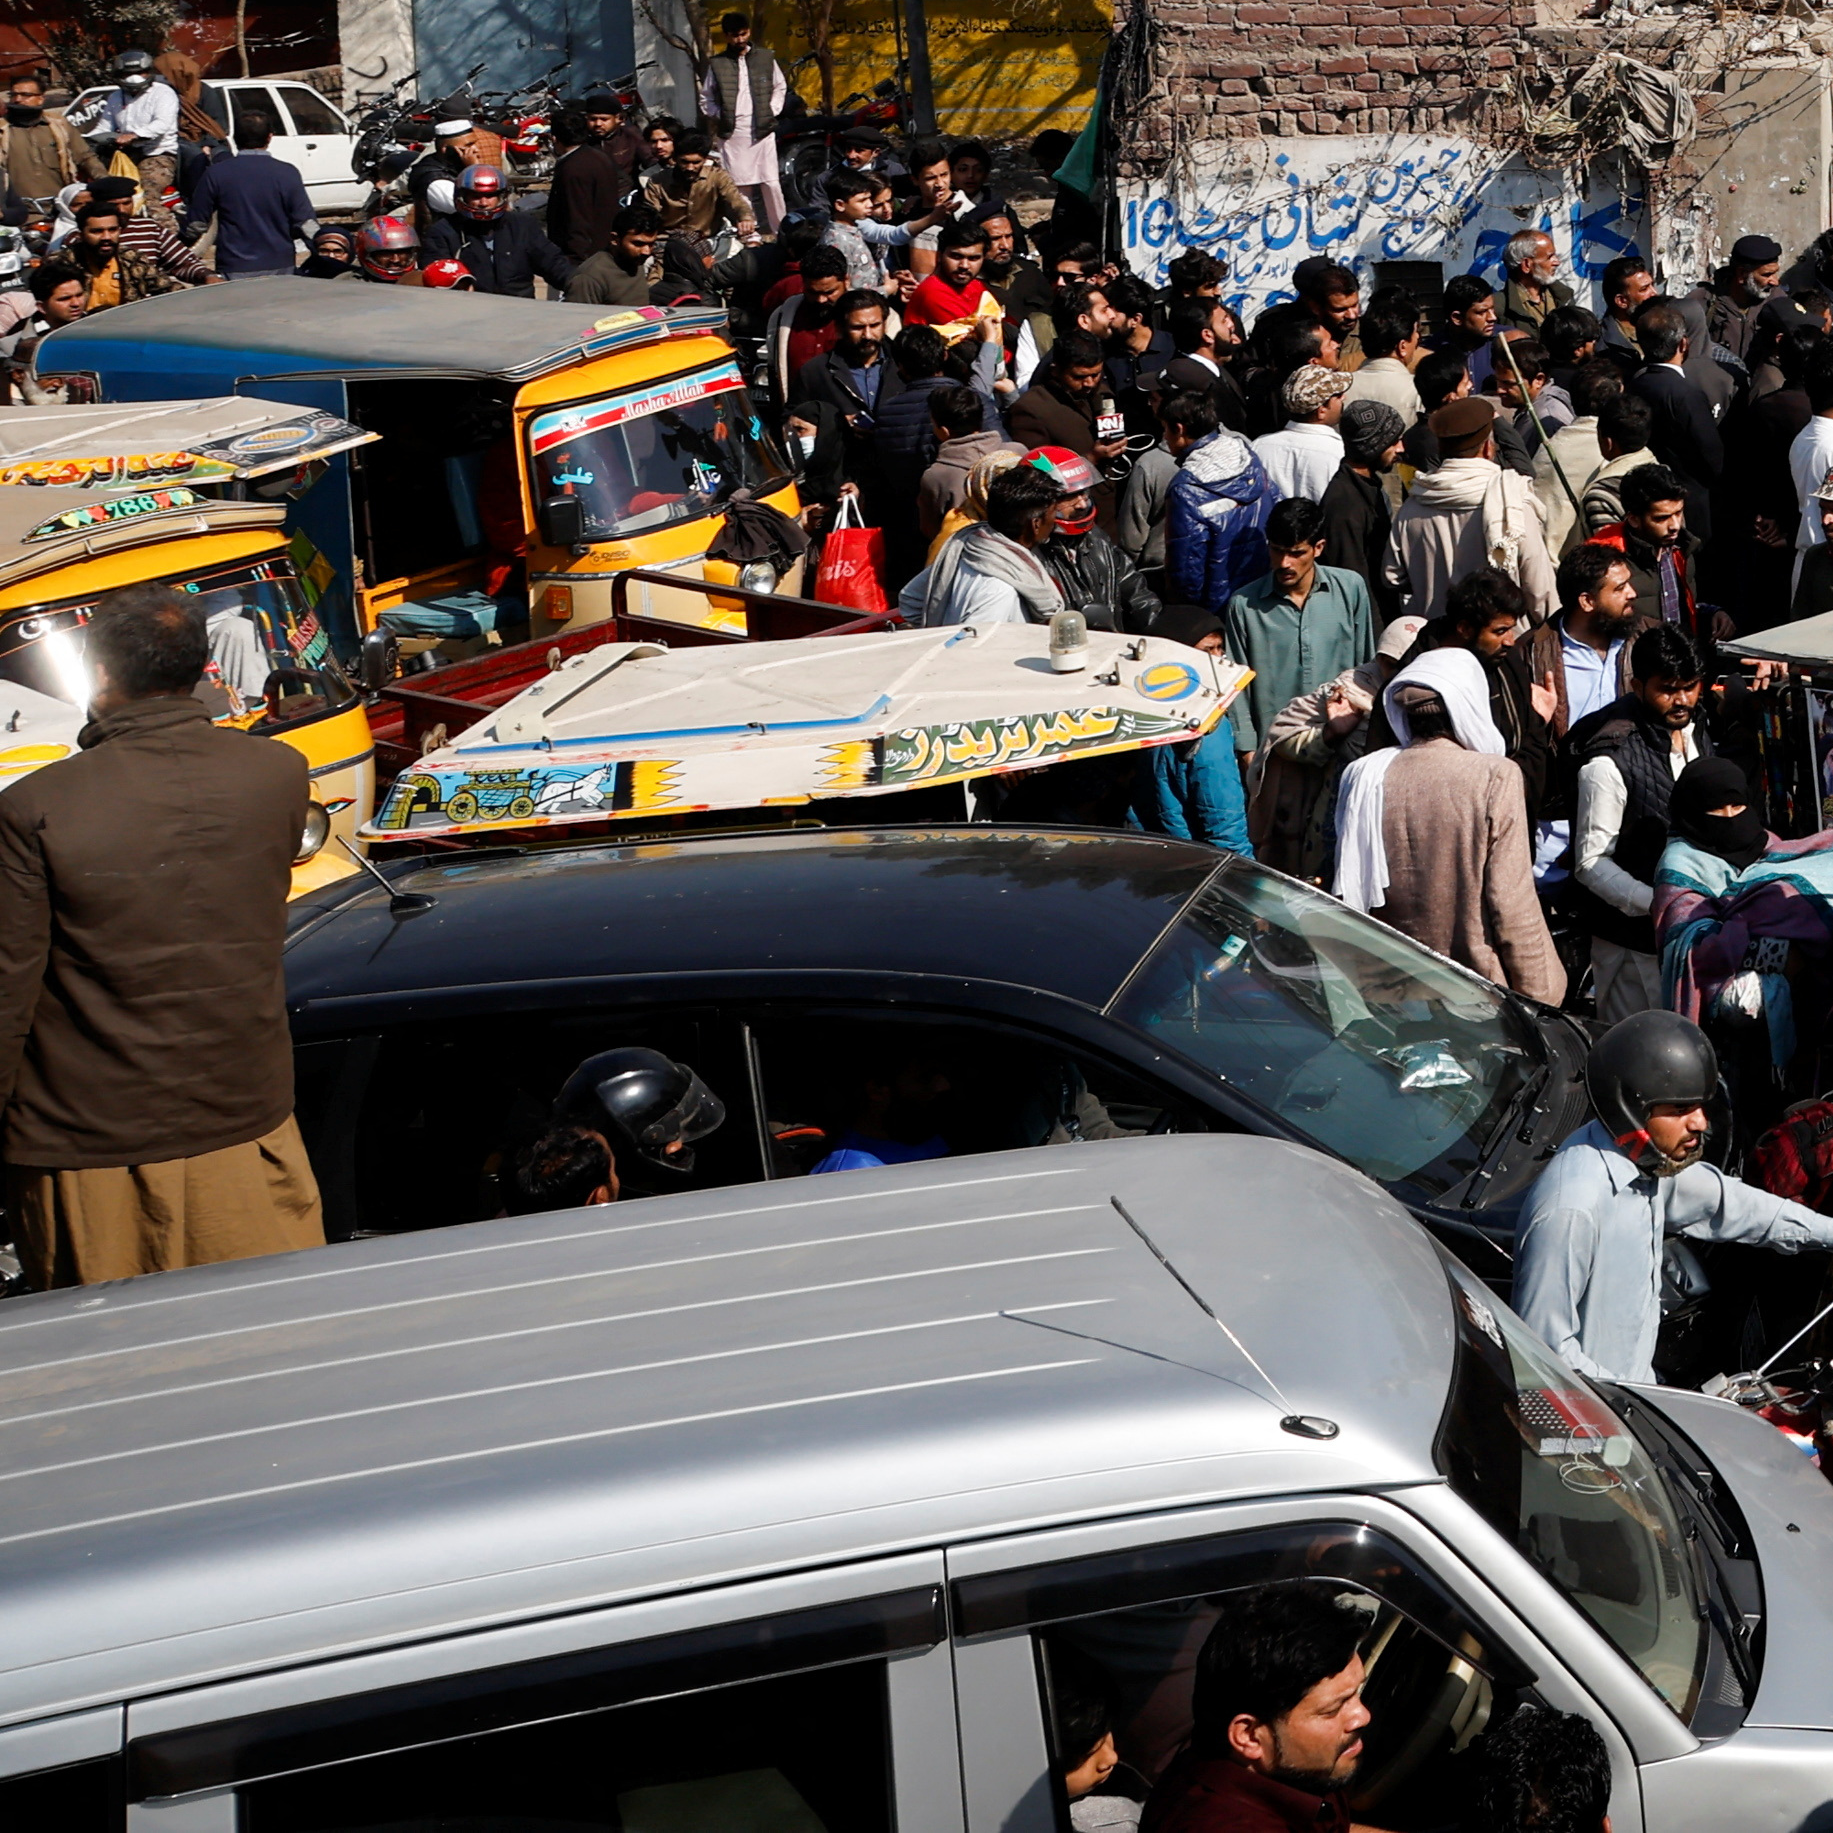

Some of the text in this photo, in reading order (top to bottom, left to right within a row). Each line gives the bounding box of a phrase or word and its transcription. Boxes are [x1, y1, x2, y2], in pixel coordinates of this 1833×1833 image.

[621, 378, 706, 418] Masha Allah
[106, 495, 158, 520] 786
[893, 705, 1121, 781] عمر ٹریڈرز
